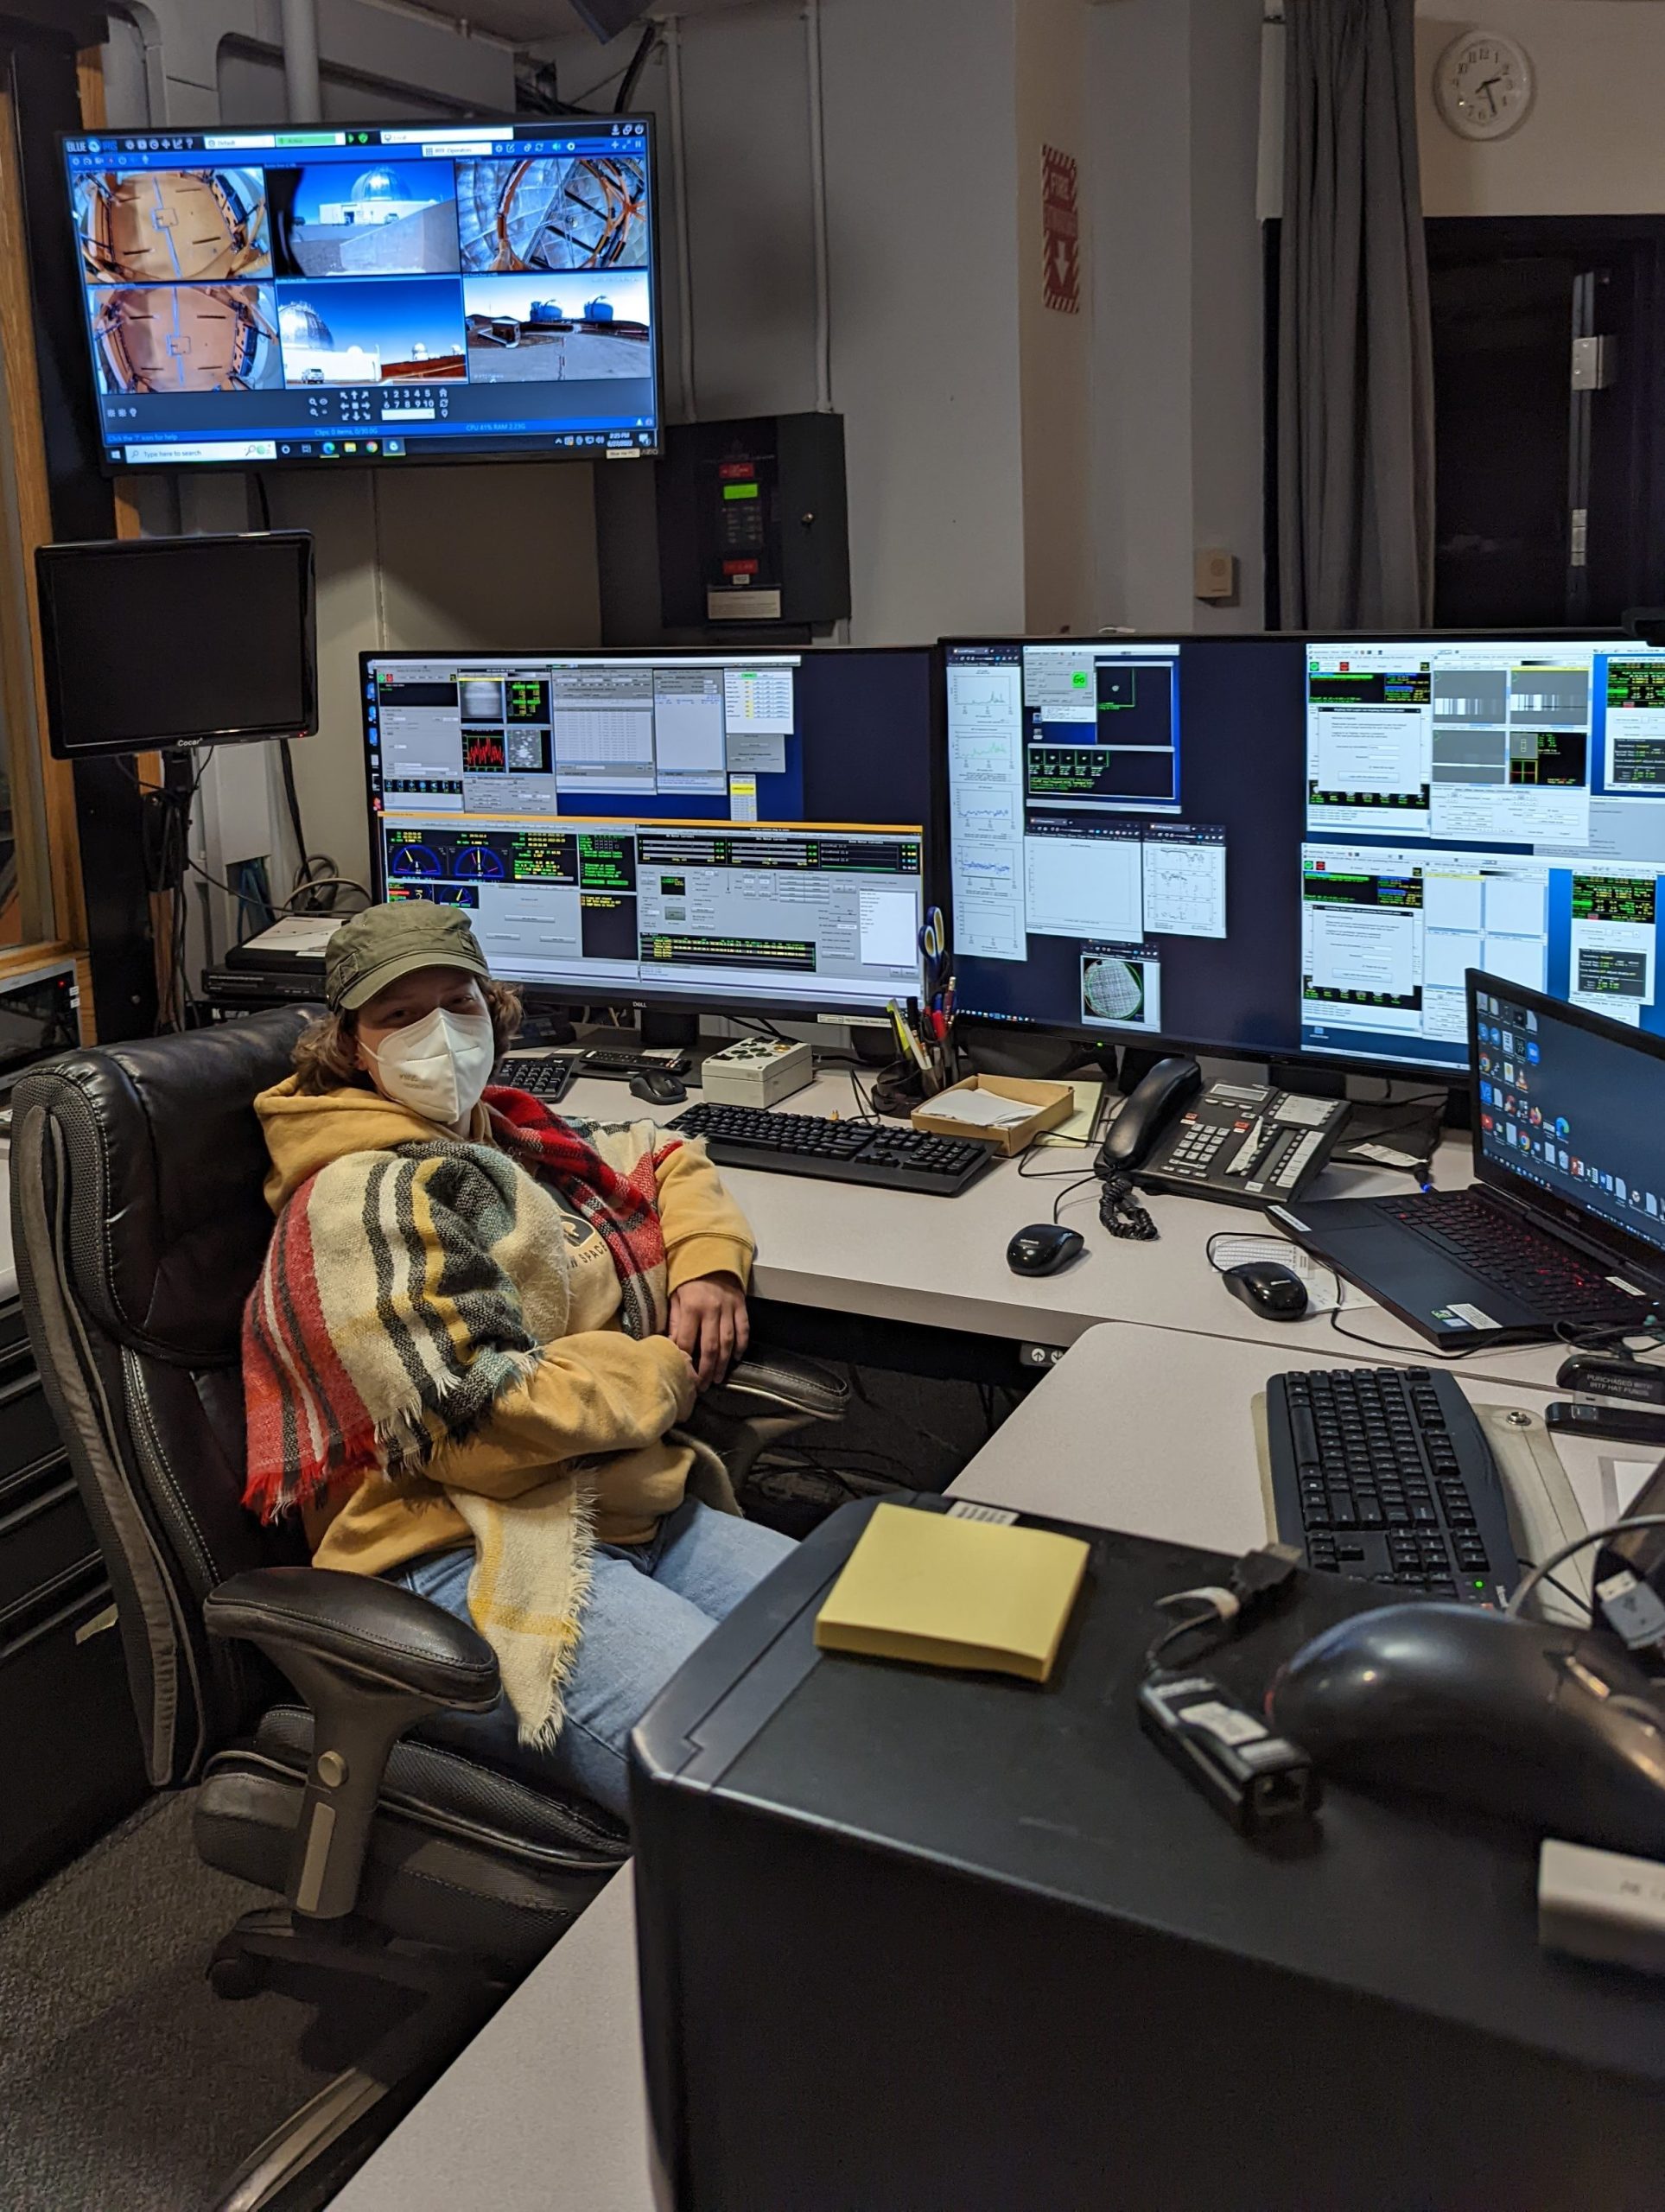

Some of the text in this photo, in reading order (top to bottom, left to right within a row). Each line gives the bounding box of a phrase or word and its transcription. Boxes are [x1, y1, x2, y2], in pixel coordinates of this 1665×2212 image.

[1479, 48, 1490, 60] 12
[66, 141, 87, 153] BLUE
[404, 390, 410, 398] 3
[414, 389, 421, 397] 4
[425, 389, 431, 397] 5
[143, 450, 159, 458] Type
[1072, 674, 1085, 683] Go
[578, 1241, 607, 1264] SPACE
[1586, 1374, 1633, 1387] PURCHASED
